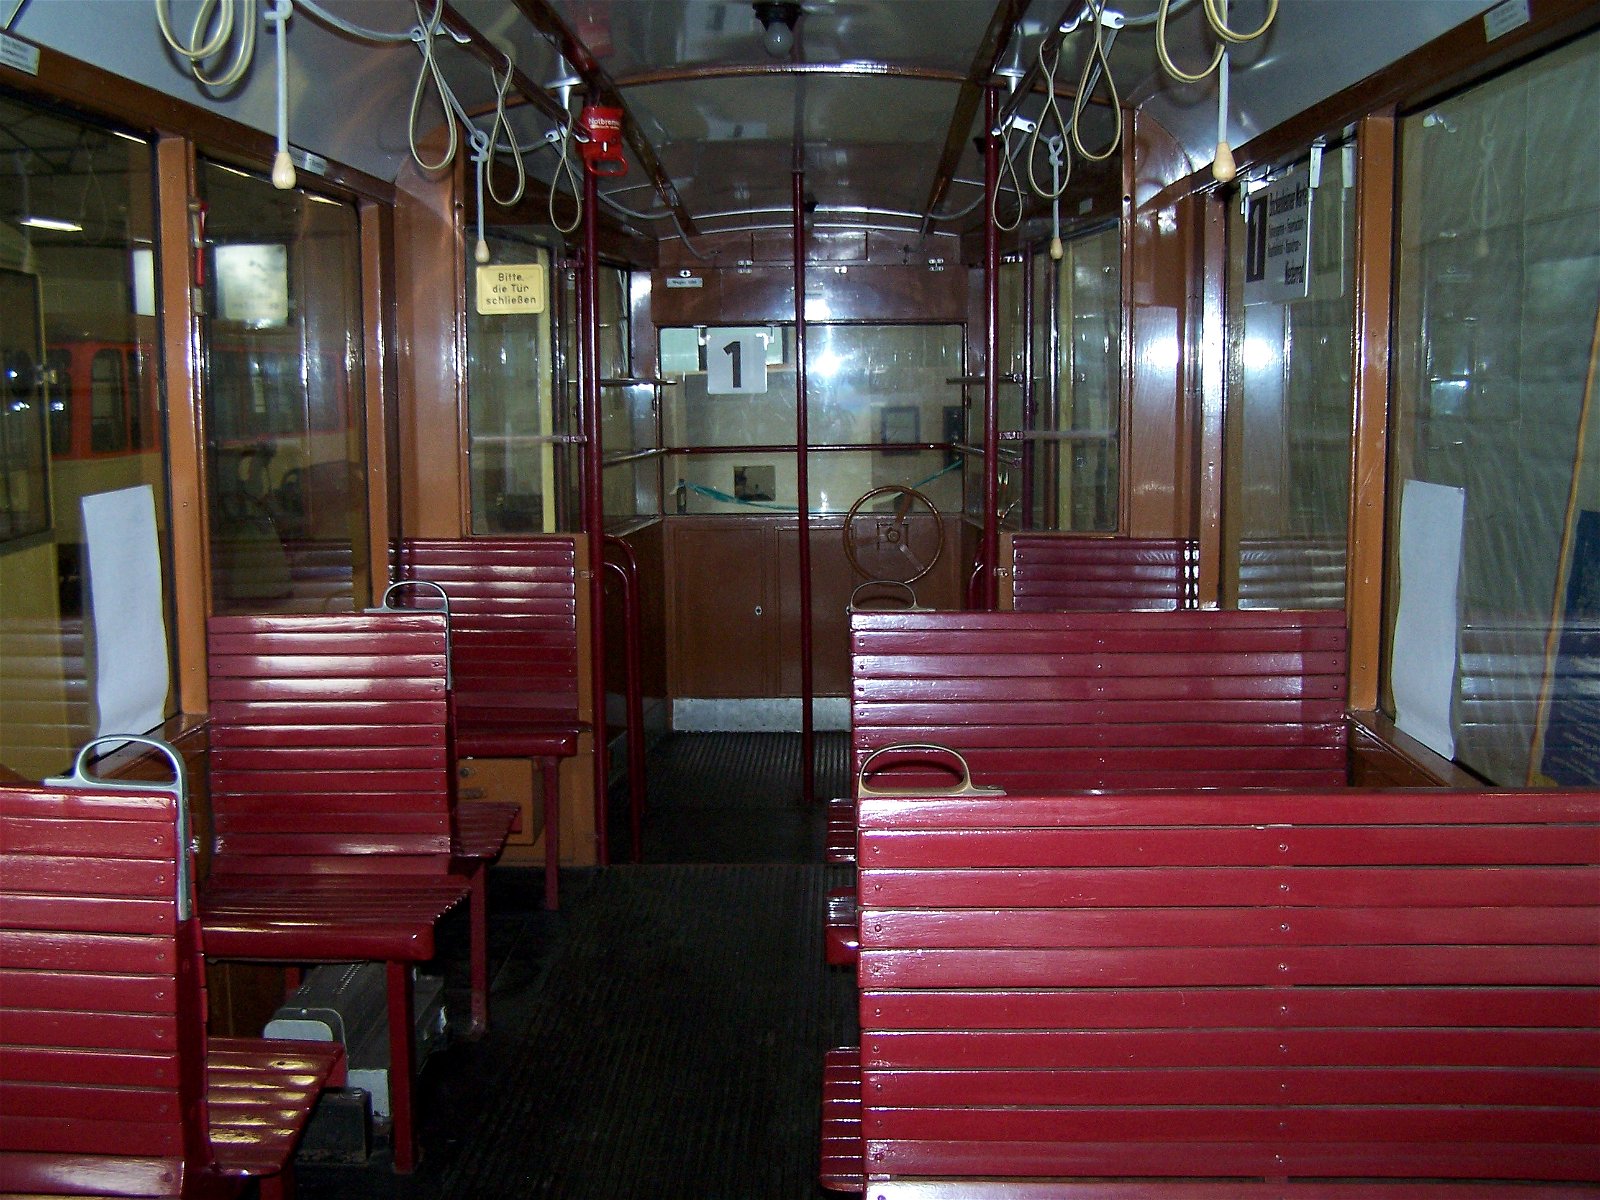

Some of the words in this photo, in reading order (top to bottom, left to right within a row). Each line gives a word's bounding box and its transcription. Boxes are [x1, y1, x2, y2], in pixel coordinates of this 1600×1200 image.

[498, 273, 522, 282] Bitte
[493, 285, 507, 293] die
[511, 284, 529, 293] Tür
[486, 296, 536, 305] schließen
[723, 341, 742, 388] 1
